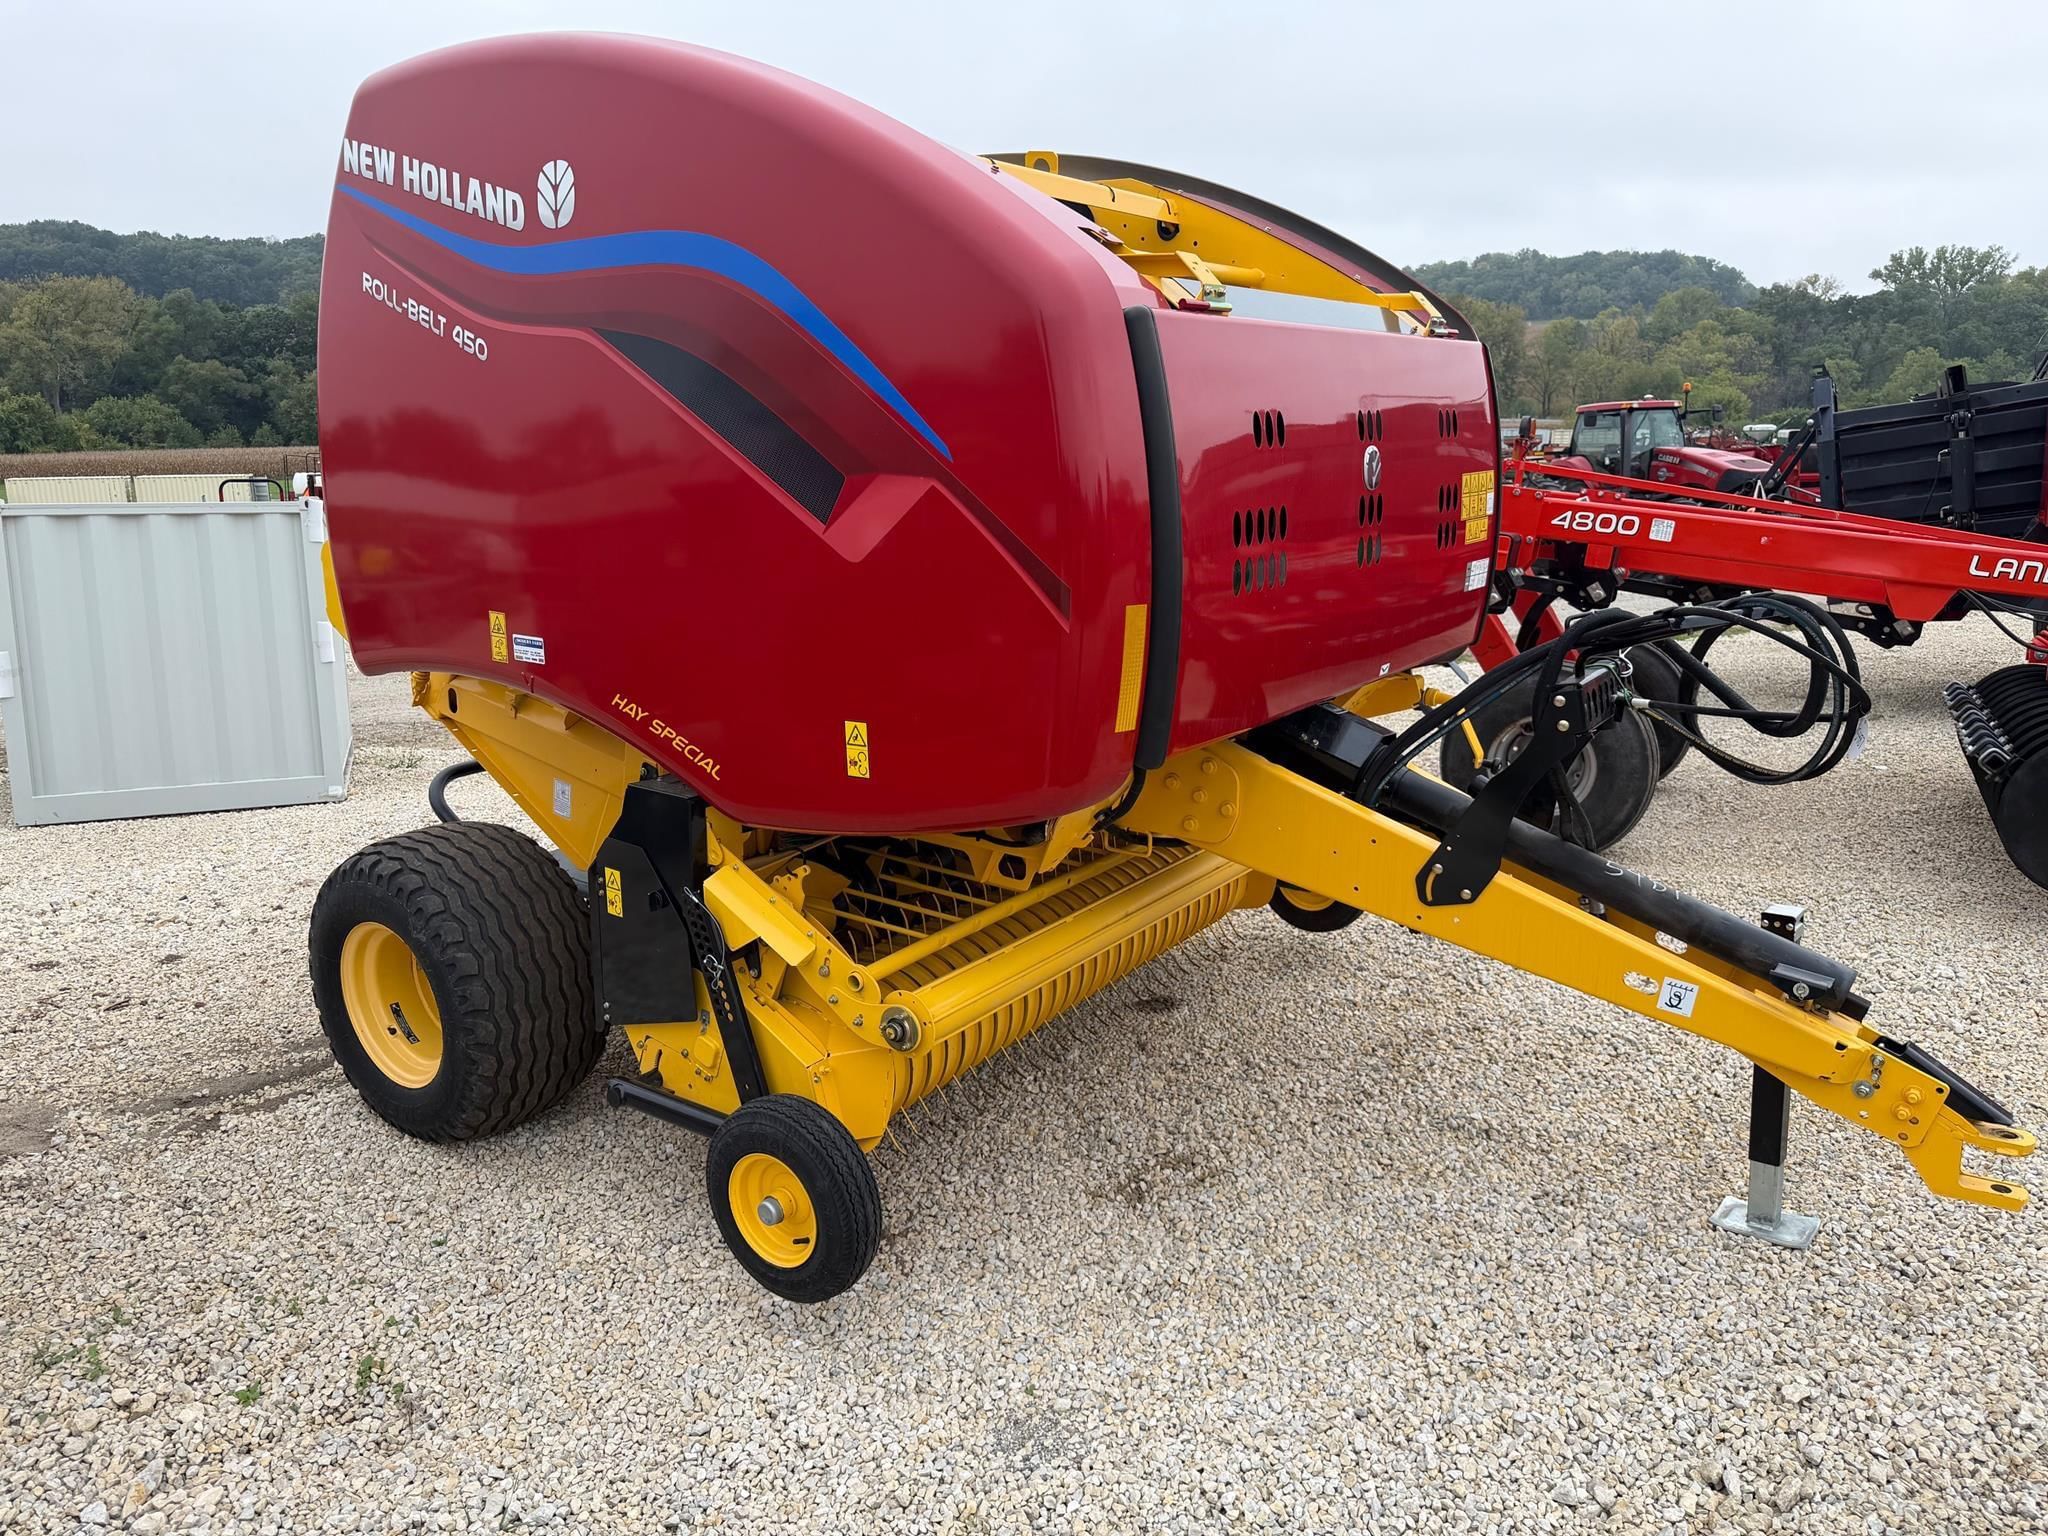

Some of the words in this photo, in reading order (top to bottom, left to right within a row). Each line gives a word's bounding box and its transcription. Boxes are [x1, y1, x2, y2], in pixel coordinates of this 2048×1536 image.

[344, 137, 396, 186] NEW
[402, 154, 525, 232] HOLLAND
[362, 271, 447, 338] ROLL-BELT
[452, 325, 488, 361] 450
[1550, 510, 1640, 536] 4800
[611, 693, 650, 721] HAY
[648, 719, 721, 781] SPECIAL
